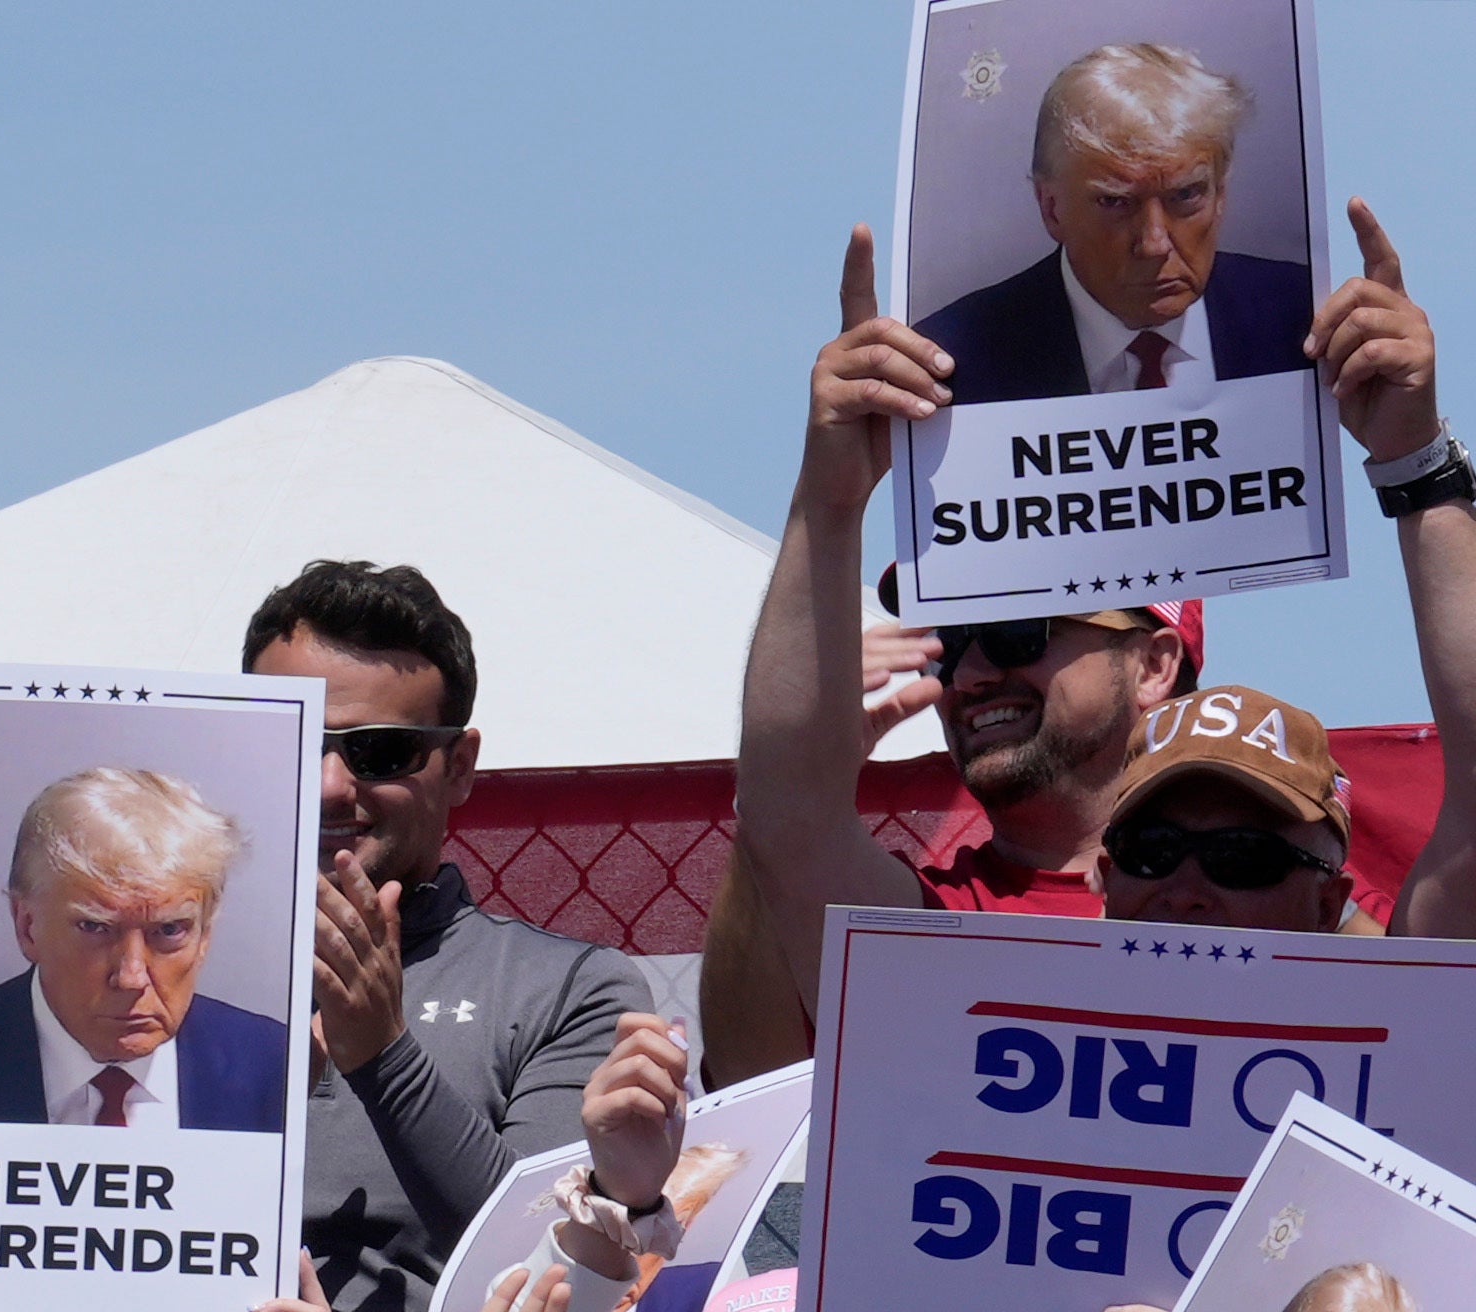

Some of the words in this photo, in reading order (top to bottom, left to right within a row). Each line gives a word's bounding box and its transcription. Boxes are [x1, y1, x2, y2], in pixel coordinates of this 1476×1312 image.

[1011, 417, 1220, 478] NEVER
[932, 467, 1307, 547] SURRENDER
[1144, 690, 1297, 765] USA
[975, 1026, 1197, 1128] RIG
[911, 1174, 1132, 1277] BIG
